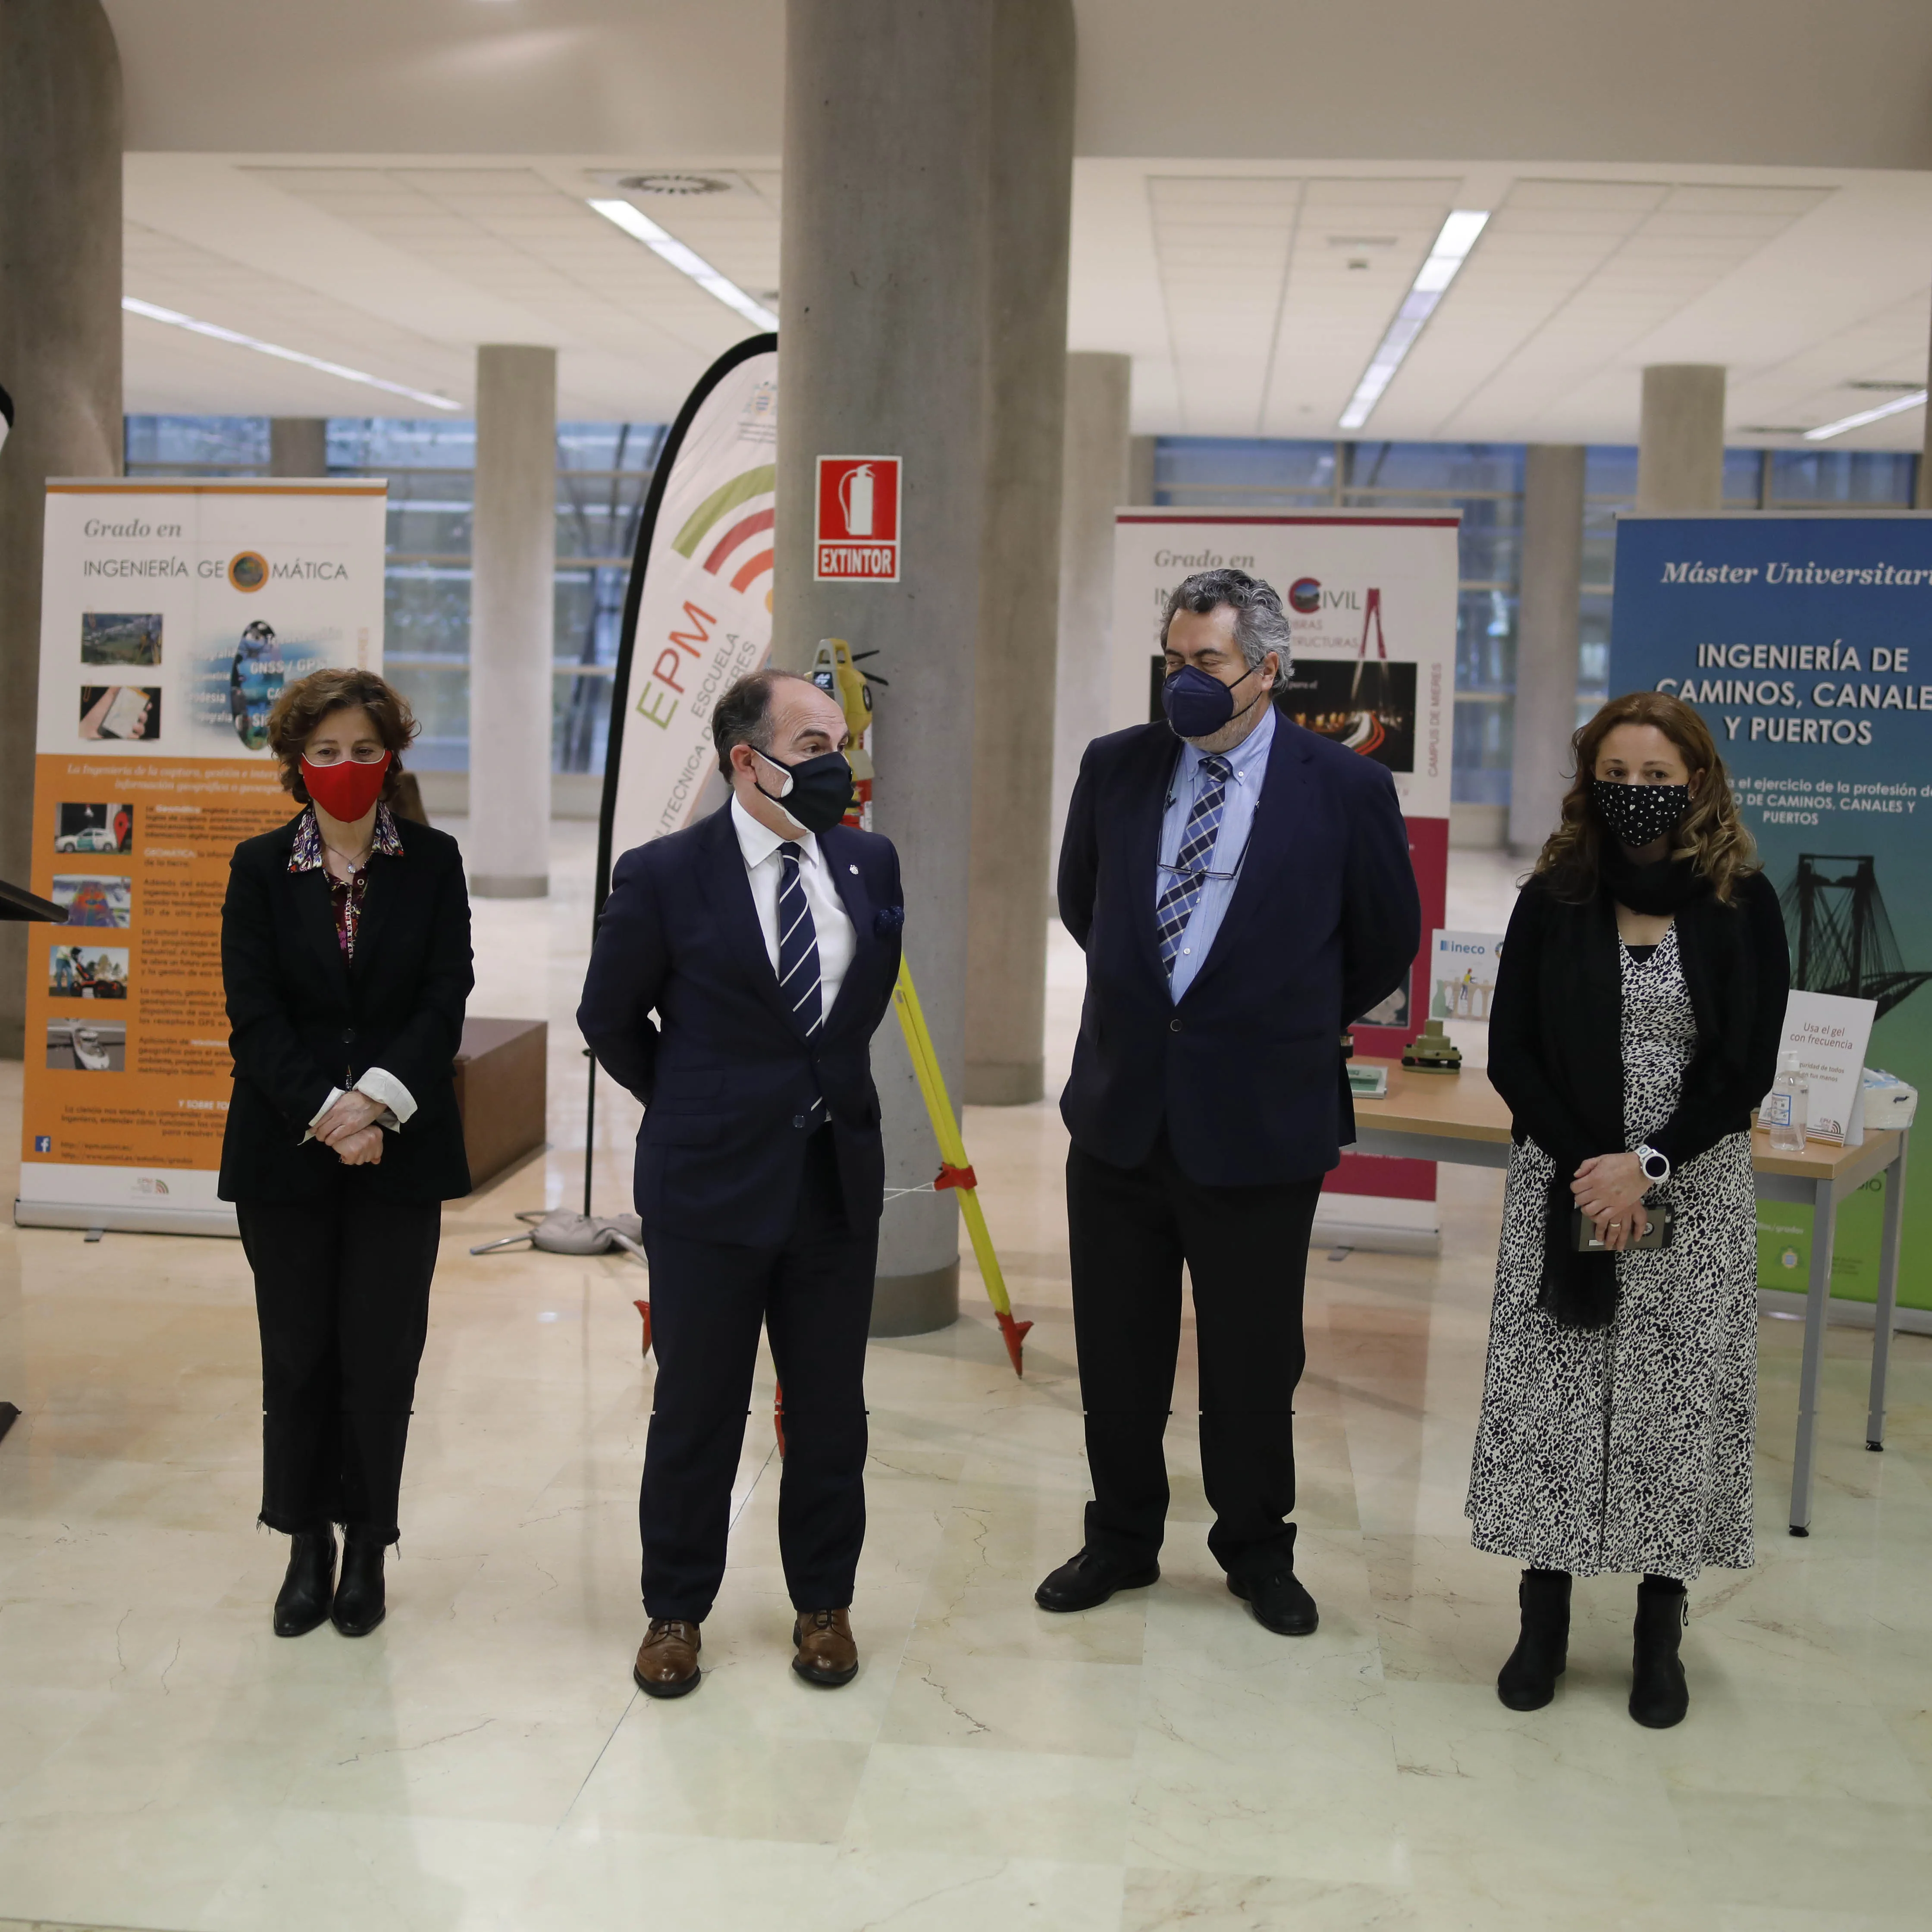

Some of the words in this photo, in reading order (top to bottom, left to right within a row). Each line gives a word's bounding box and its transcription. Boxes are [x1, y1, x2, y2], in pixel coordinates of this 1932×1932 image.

[85, 519, 151, 538] Grado
[157, 523, 182, 538] en
[84, 556, 189, 578] INGENIERÍA
[820, 549, 893, 574] EXTINTOR
[1154, 549, 1223, 569] Grado
[1229, 553, 1255, 568] en
[1660, 561, 1758, 583] Máster
[1766, 561, 1932, 586] Universitari
[635, 600, 717, 730] EPM
[1697, 639, 1860, 671] INGENIERÍA
[1872, 648, 1908, 672] DE
[250, 661, 285, 674] GNSS
[690, 632, 740, 719] ESCUELA
[1813, 682, 1932, 710] CANALE
[1724, 716, 1741, 739] Y
[1751, 717, 1872, 746] PUERTOS
[651, 744, 707, 841] OLITECNICA
[1738, 778, 1750, 789] el
[1754, 778, 1811, 794] ejercicio
[1816, 780, 1834, 792] de
[1838, 781, 1850, 794] la
[1854, 782, 1916, 798] profesión
[1921, 784, 1932, 797] d
[1747, 794, 1763, 806] DE
[1768, 794, 1836, 811] CAMINOS,
[1840, 799, 1903, 813] CANALES
[1907, 801, 1916, 814] Y
[1763, 811, 1819, 825] PUERTOS
[1451, 940, 1485, 955] ineco
[1803, 1022, 1819, 1033] Usa
[1821, 1026, 1830, 1035] el
[1832, 1027, 1846, 1038] gel
[1790, 1033, 1806, 1043] con
[1807, 1034, 1853, 1050] frecuencia
[1799, 1062, 1820, 1071] guridad
[1829, 1065, 1844, 1074] todos
[1819, 1074, 1838, 1083] manos
